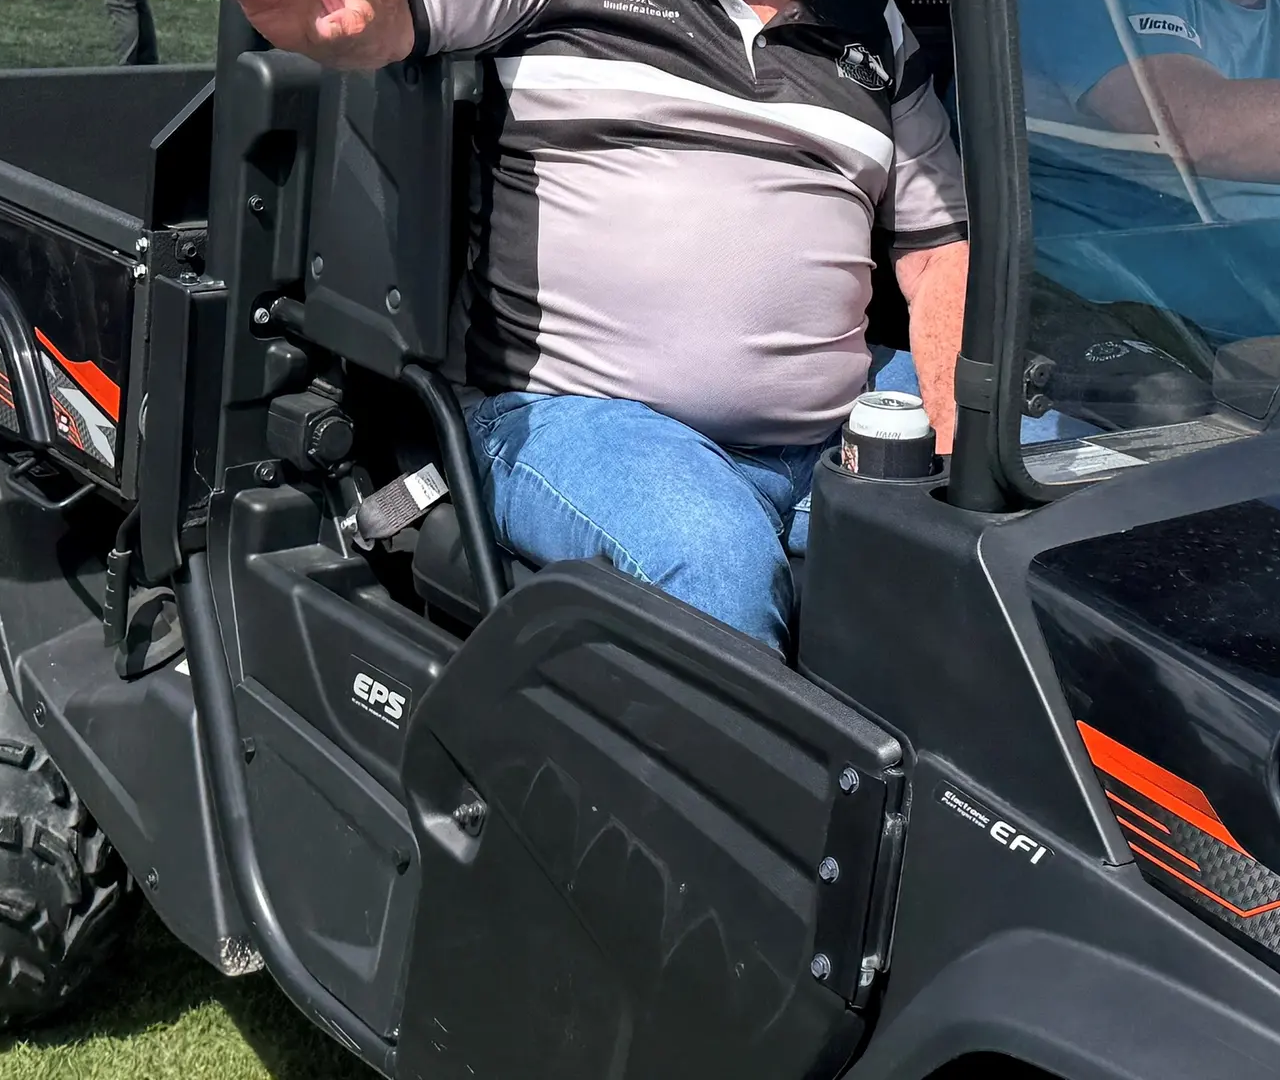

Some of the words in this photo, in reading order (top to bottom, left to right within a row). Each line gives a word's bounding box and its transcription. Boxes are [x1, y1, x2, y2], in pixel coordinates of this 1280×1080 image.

[353, 672, 406, 720] EPS
[944, 790, 991, 824] Electronic
[989, 820, 1047, 865] EFI
